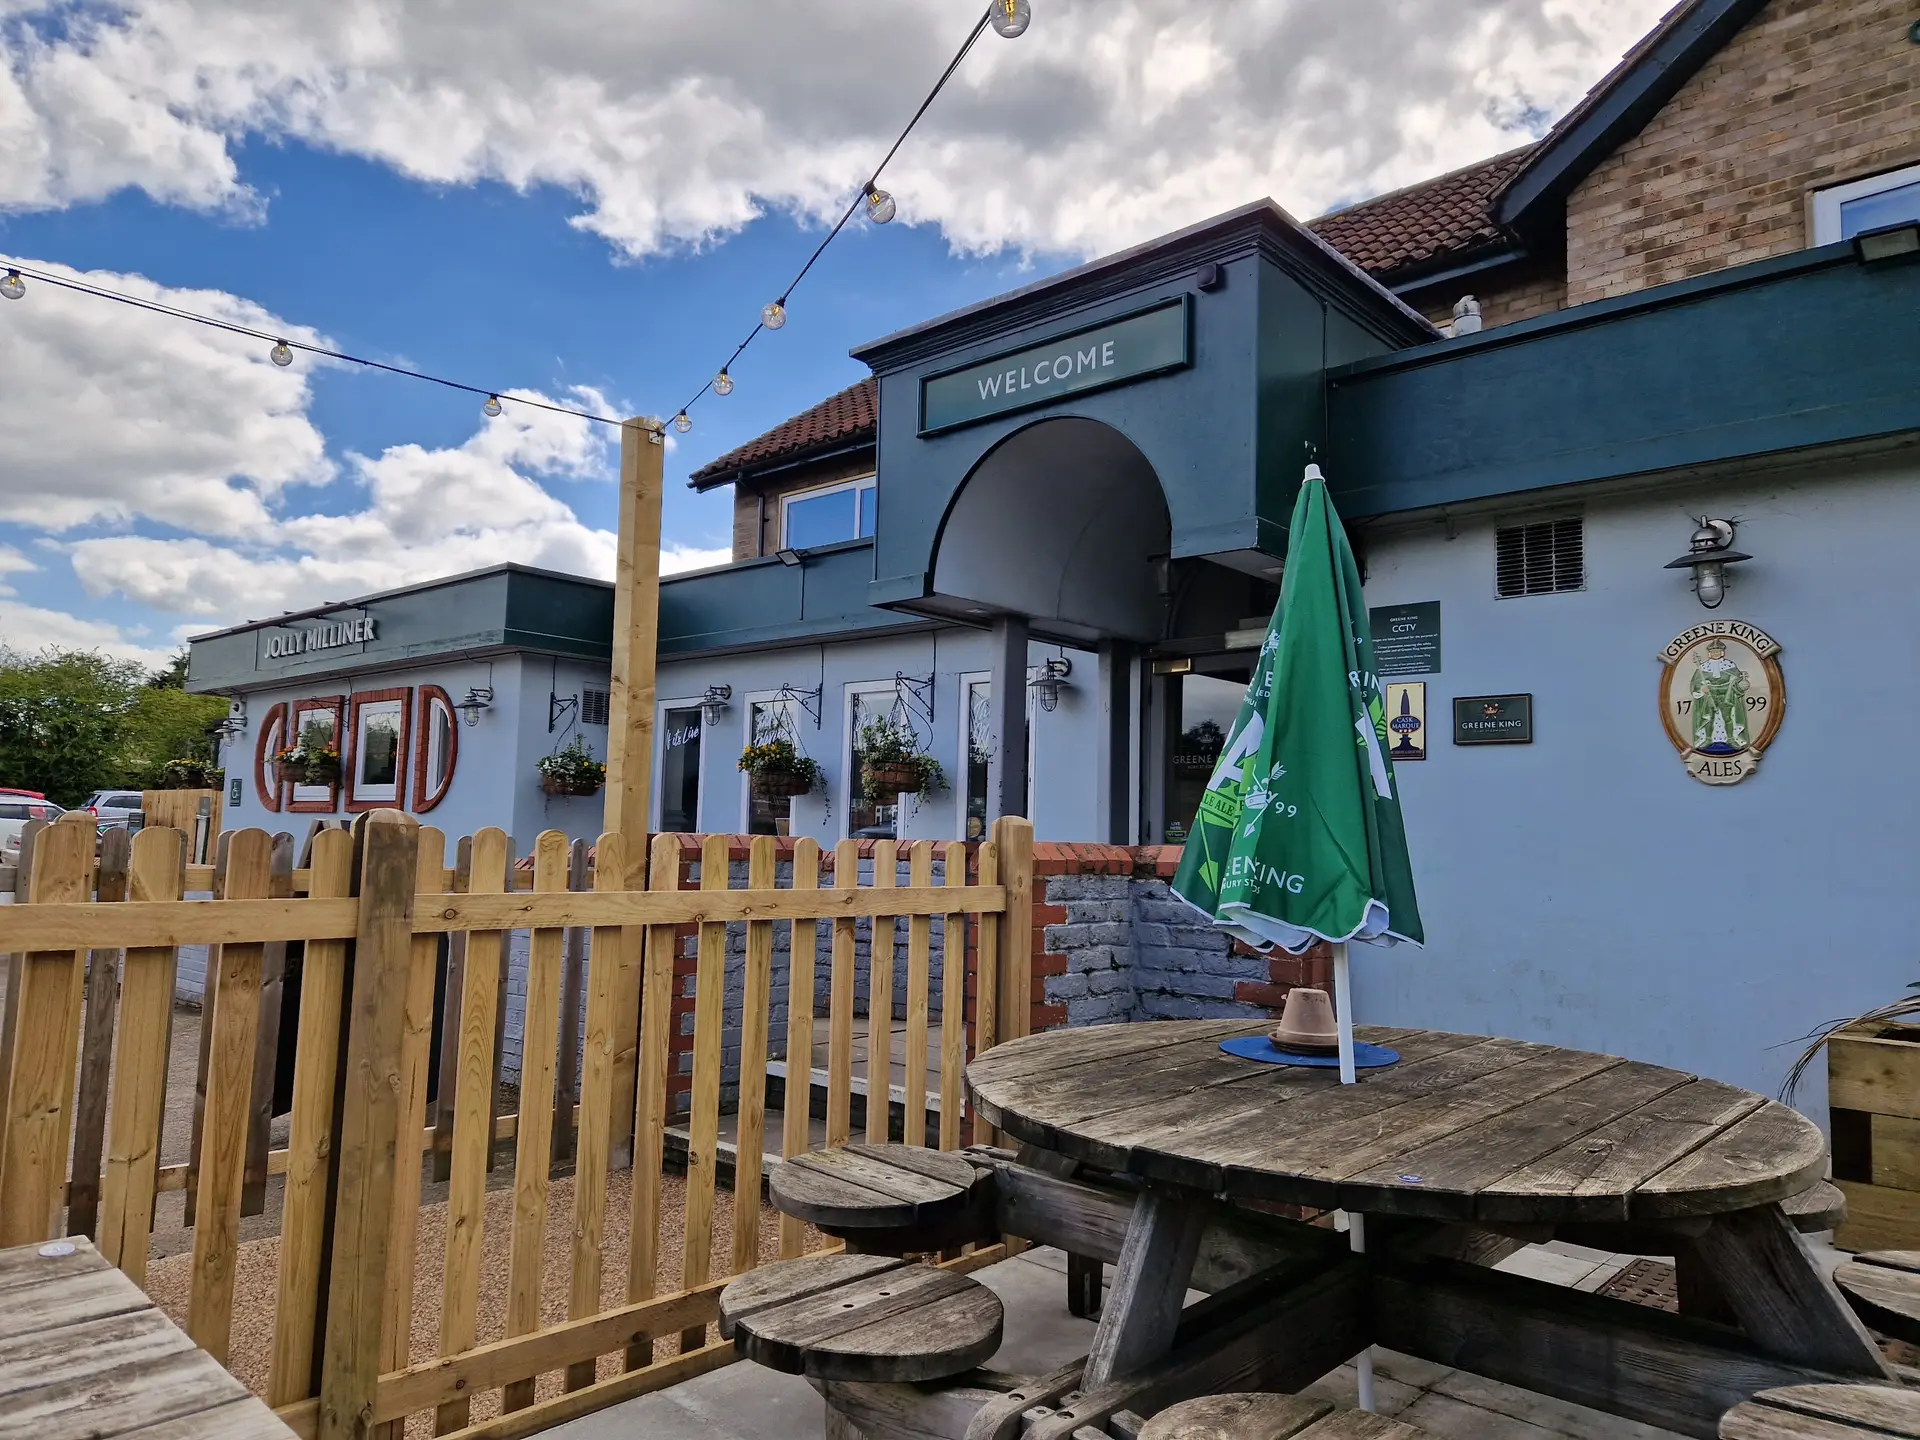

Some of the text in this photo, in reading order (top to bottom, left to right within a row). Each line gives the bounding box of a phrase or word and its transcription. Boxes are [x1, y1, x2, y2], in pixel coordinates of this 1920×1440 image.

[978, 341, 1115, 400] WELCOME
[1392, 623, 1417, 633] CCTV
[264, 617, 375, 659] JOLLY MILLINER
[1667, 622, 1770, 657] GREENE KING
[1676, 696, 1767, 715] 17 99
[1461, 720, 1522, 729] GREENE KING
[1172, 754, 1213, 764] GREENE
[1697, 760, 1742, 777] ALES
[1215, 801, 1235, 817] ALE
[1275, 801, 1297, 818] 99
